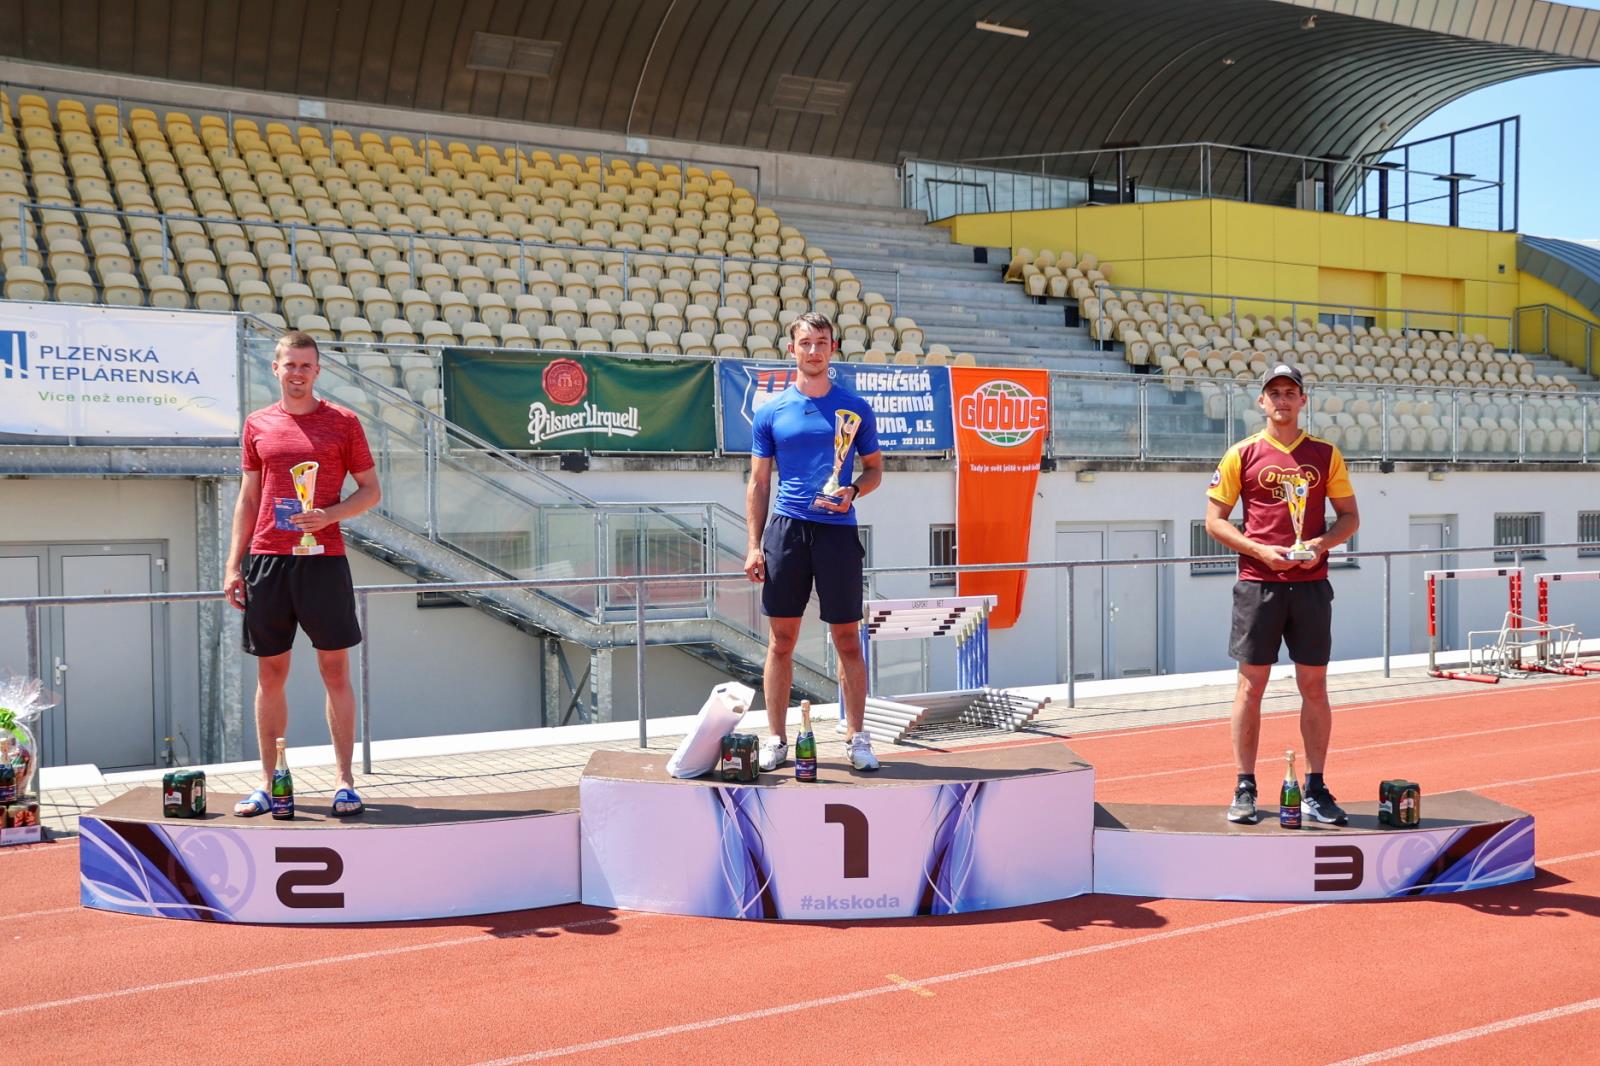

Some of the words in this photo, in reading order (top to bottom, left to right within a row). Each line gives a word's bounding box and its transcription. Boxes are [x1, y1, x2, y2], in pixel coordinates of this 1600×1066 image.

[40, 344, 159, 363] PLZEŇSKÁ
[35, 365, 200, 384] TEPLÁRENSKÁ
[856, 369, 931, 391] HASIČSKÁ
[81, 392, 112, 403] než
[116, 394, 178, 406] energie
[862, 392, 934, 413] ZÁJEMNÁ
[528, 402, 586, 445] Pilsner
[825, 804, 869, 878] 1
[275, 847, 344, 908] 2
[1314, 845, 1364, 891] 3
[800, 894, 900, 910] #akskoda
